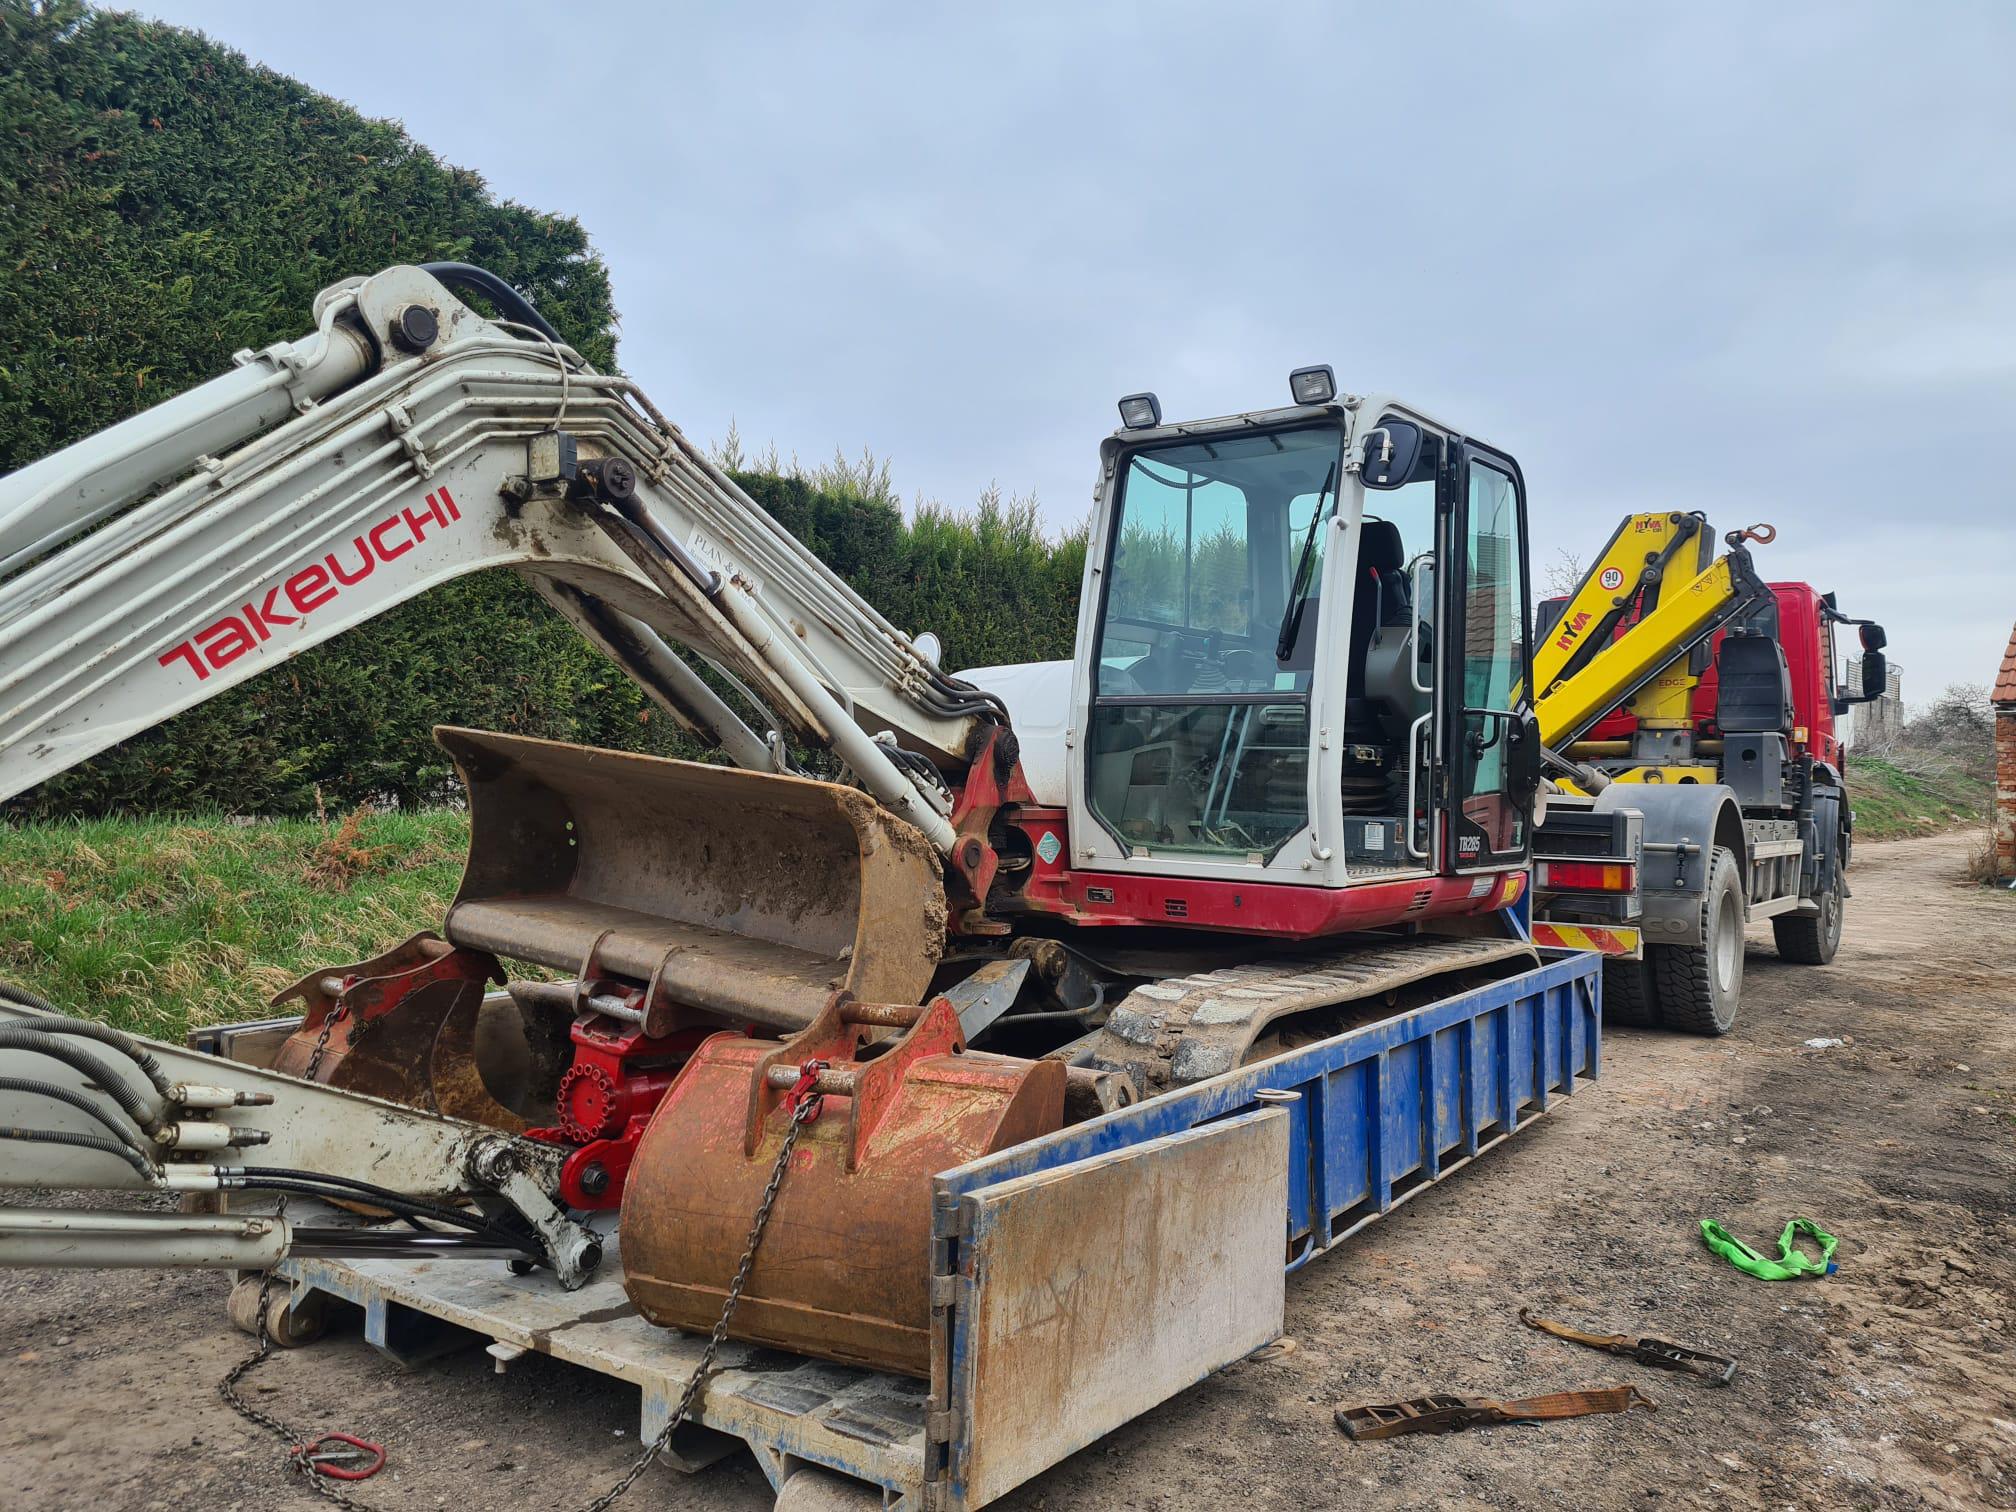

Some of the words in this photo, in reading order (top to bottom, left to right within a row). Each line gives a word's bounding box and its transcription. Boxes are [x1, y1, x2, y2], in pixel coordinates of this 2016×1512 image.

[1636, 518, 1662, 529] HYVA
[694, 534, 724, 564] PLAN
[724, 561, 734, 574] &
[1605, 571, 1618, 582] 90
[1556, 612, 1592, 651] HYVA
[1659, 678, 1686, 687] EDGE
[1459, 836, 1480, 852] TB285
